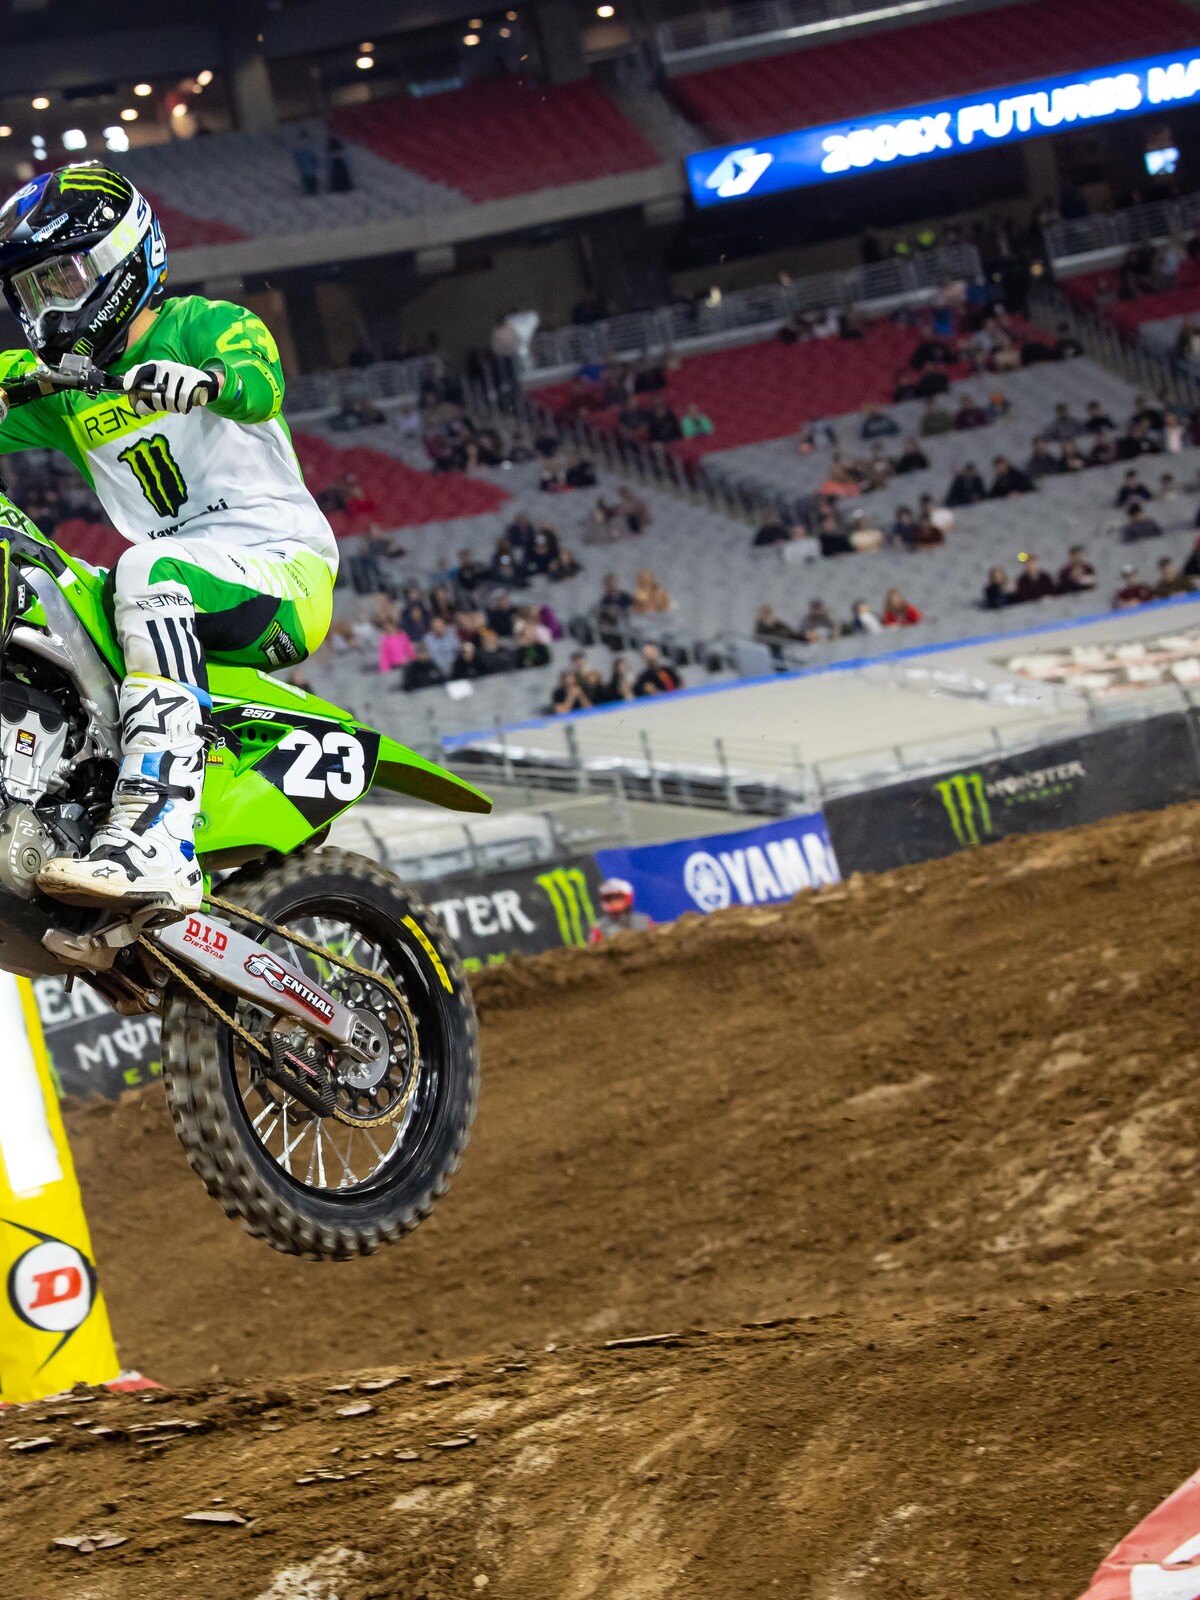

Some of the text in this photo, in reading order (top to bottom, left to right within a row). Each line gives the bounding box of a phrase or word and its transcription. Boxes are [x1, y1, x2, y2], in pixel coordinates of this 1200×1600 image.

[957, 74, 1142, 144] FUTURES
[89, 272, 136, 332] MONSTER
[241, 708, 276, 720] 250
[207, 755, 223, 763] SON
[278, 729, 365, 801] 23
[719, 833, 836, 905] YAMA
[186, 918, 228, 951] D.I.D
[431, 889, 536, 940] TER
